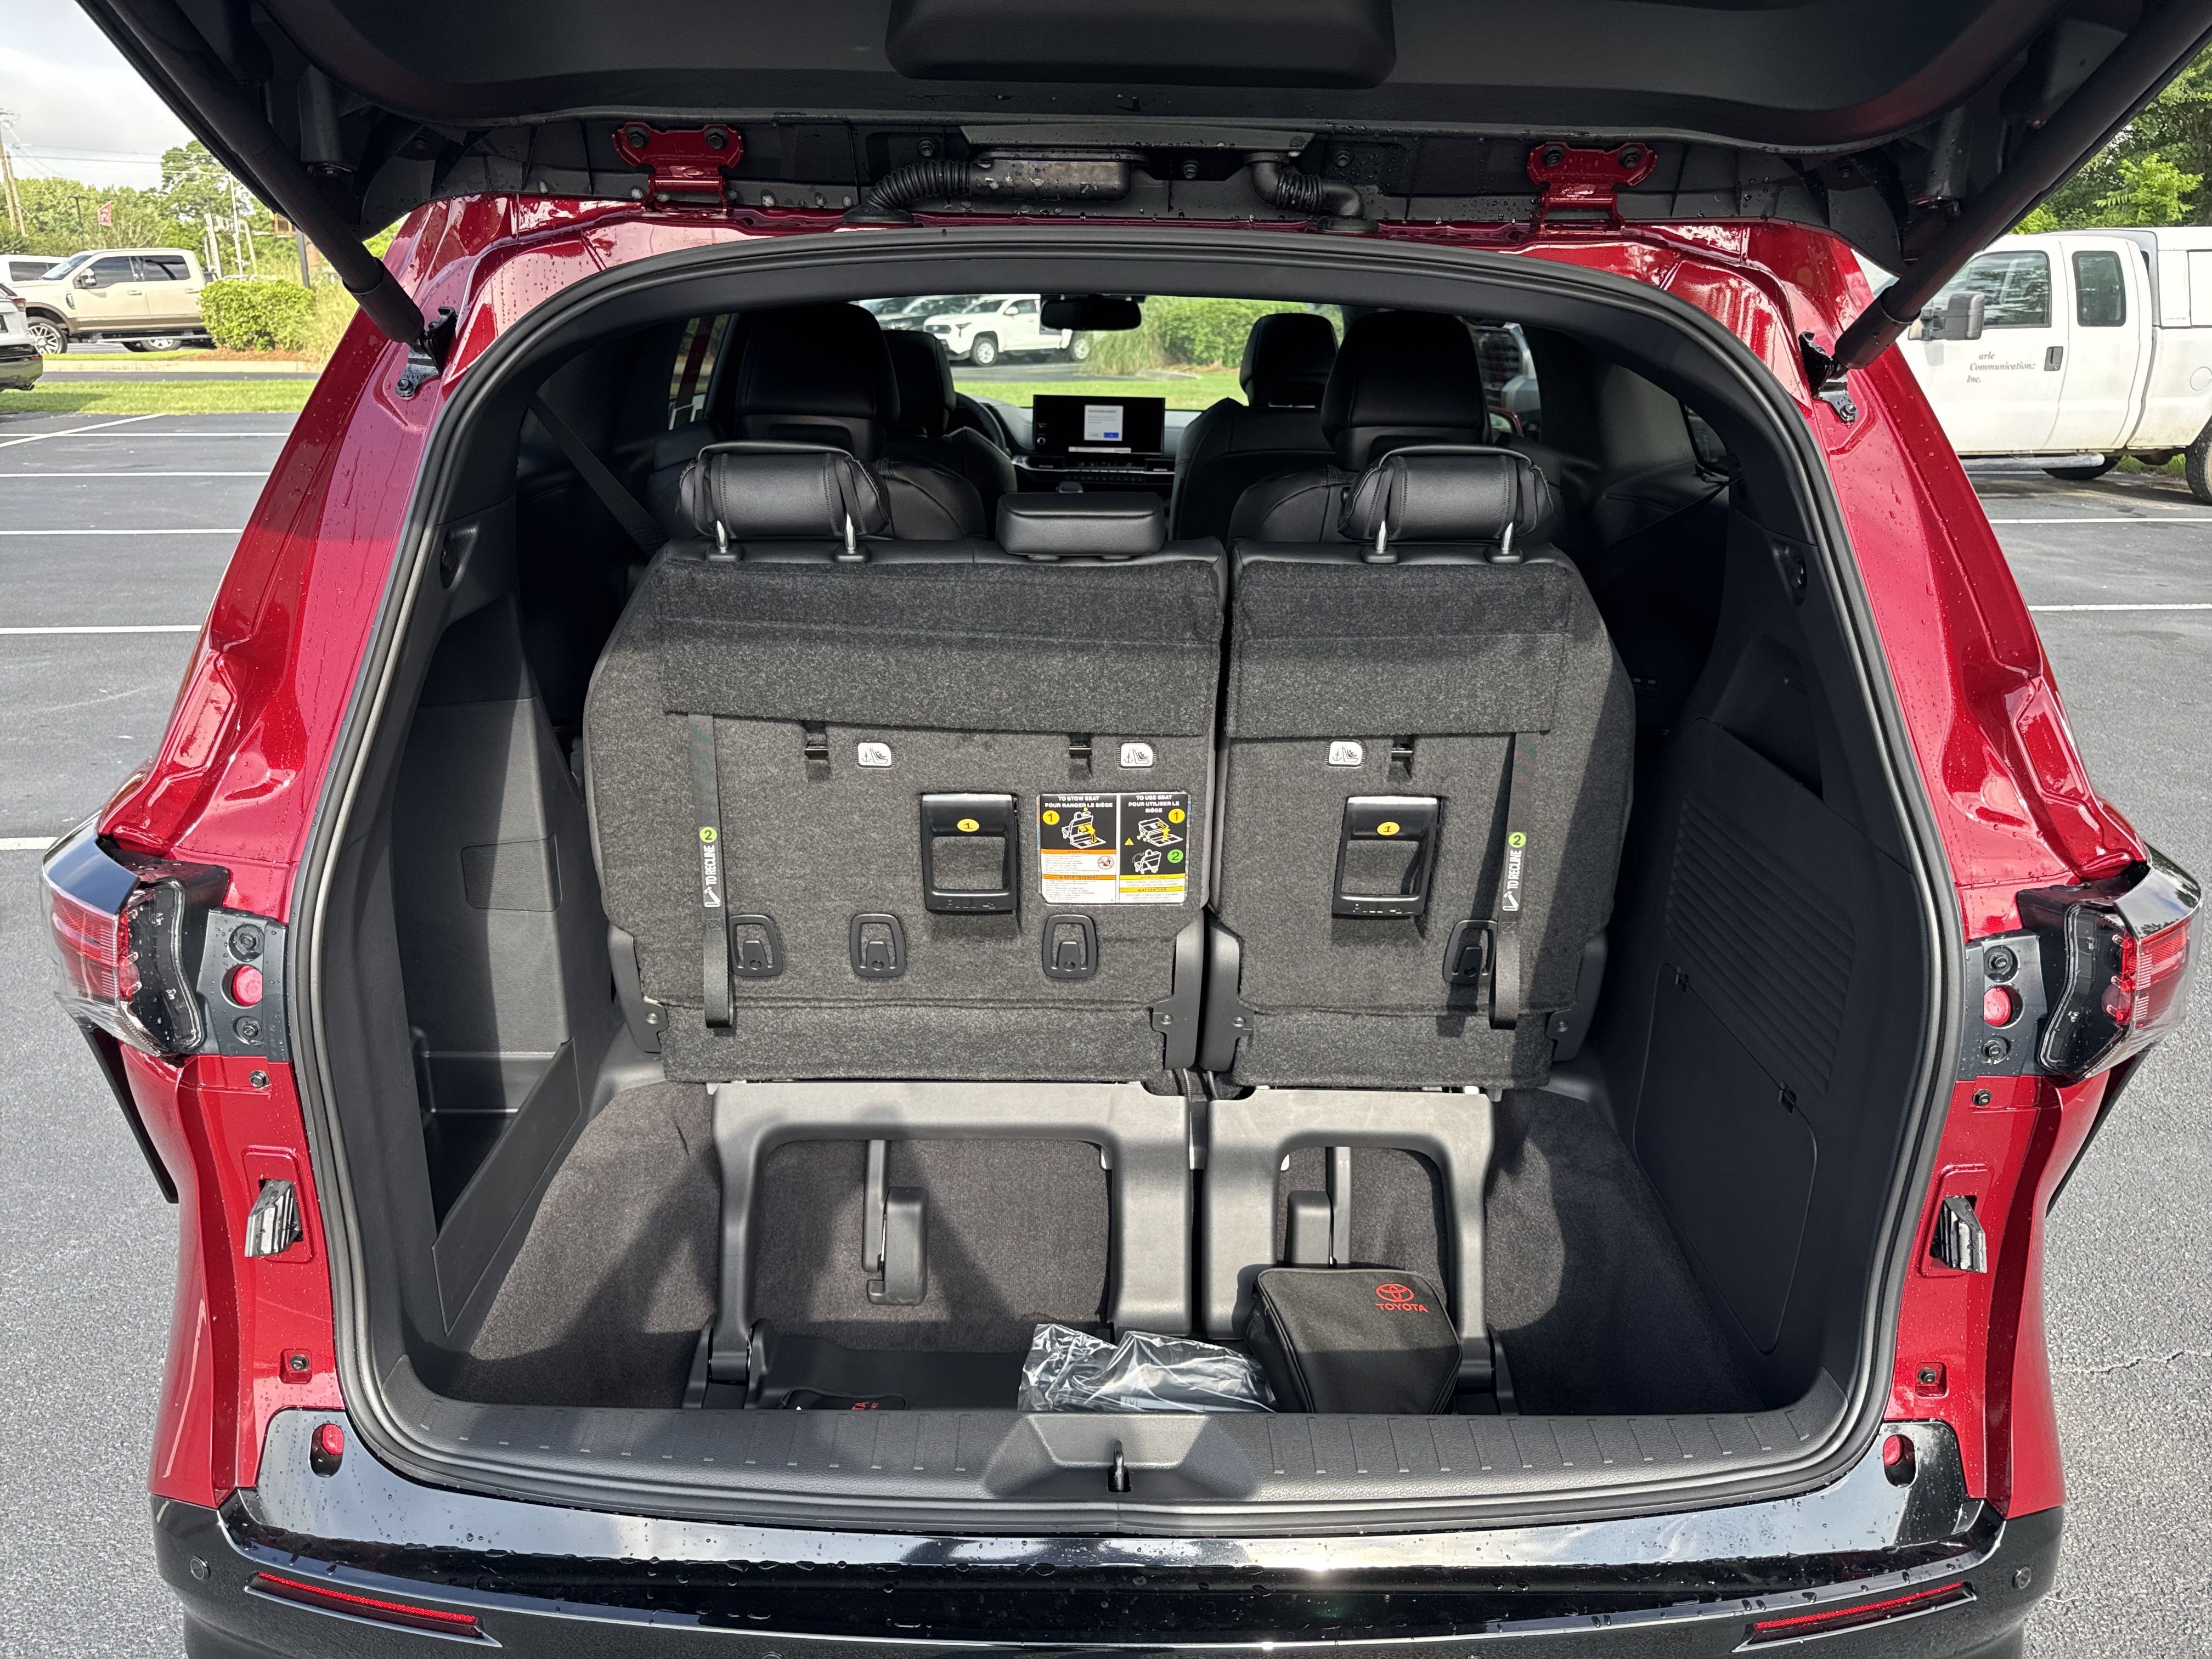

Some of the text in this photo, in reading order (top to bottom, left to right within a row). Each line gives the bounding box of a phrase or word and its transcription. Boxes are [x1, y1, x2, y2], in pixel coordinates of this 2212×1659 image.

[1970, 362, 2036, 371] Communications
[704, 830, 713, 840] 2
[1513, 835, 1521, 845] 2
[1171, 851, 1180, 861] 2
[703, 845, 717, 885] TO RECLINE
[1507, 849, 1522, 890] TO RECLINE
[1376, 1303, 1428, 1313] TOYOTA
